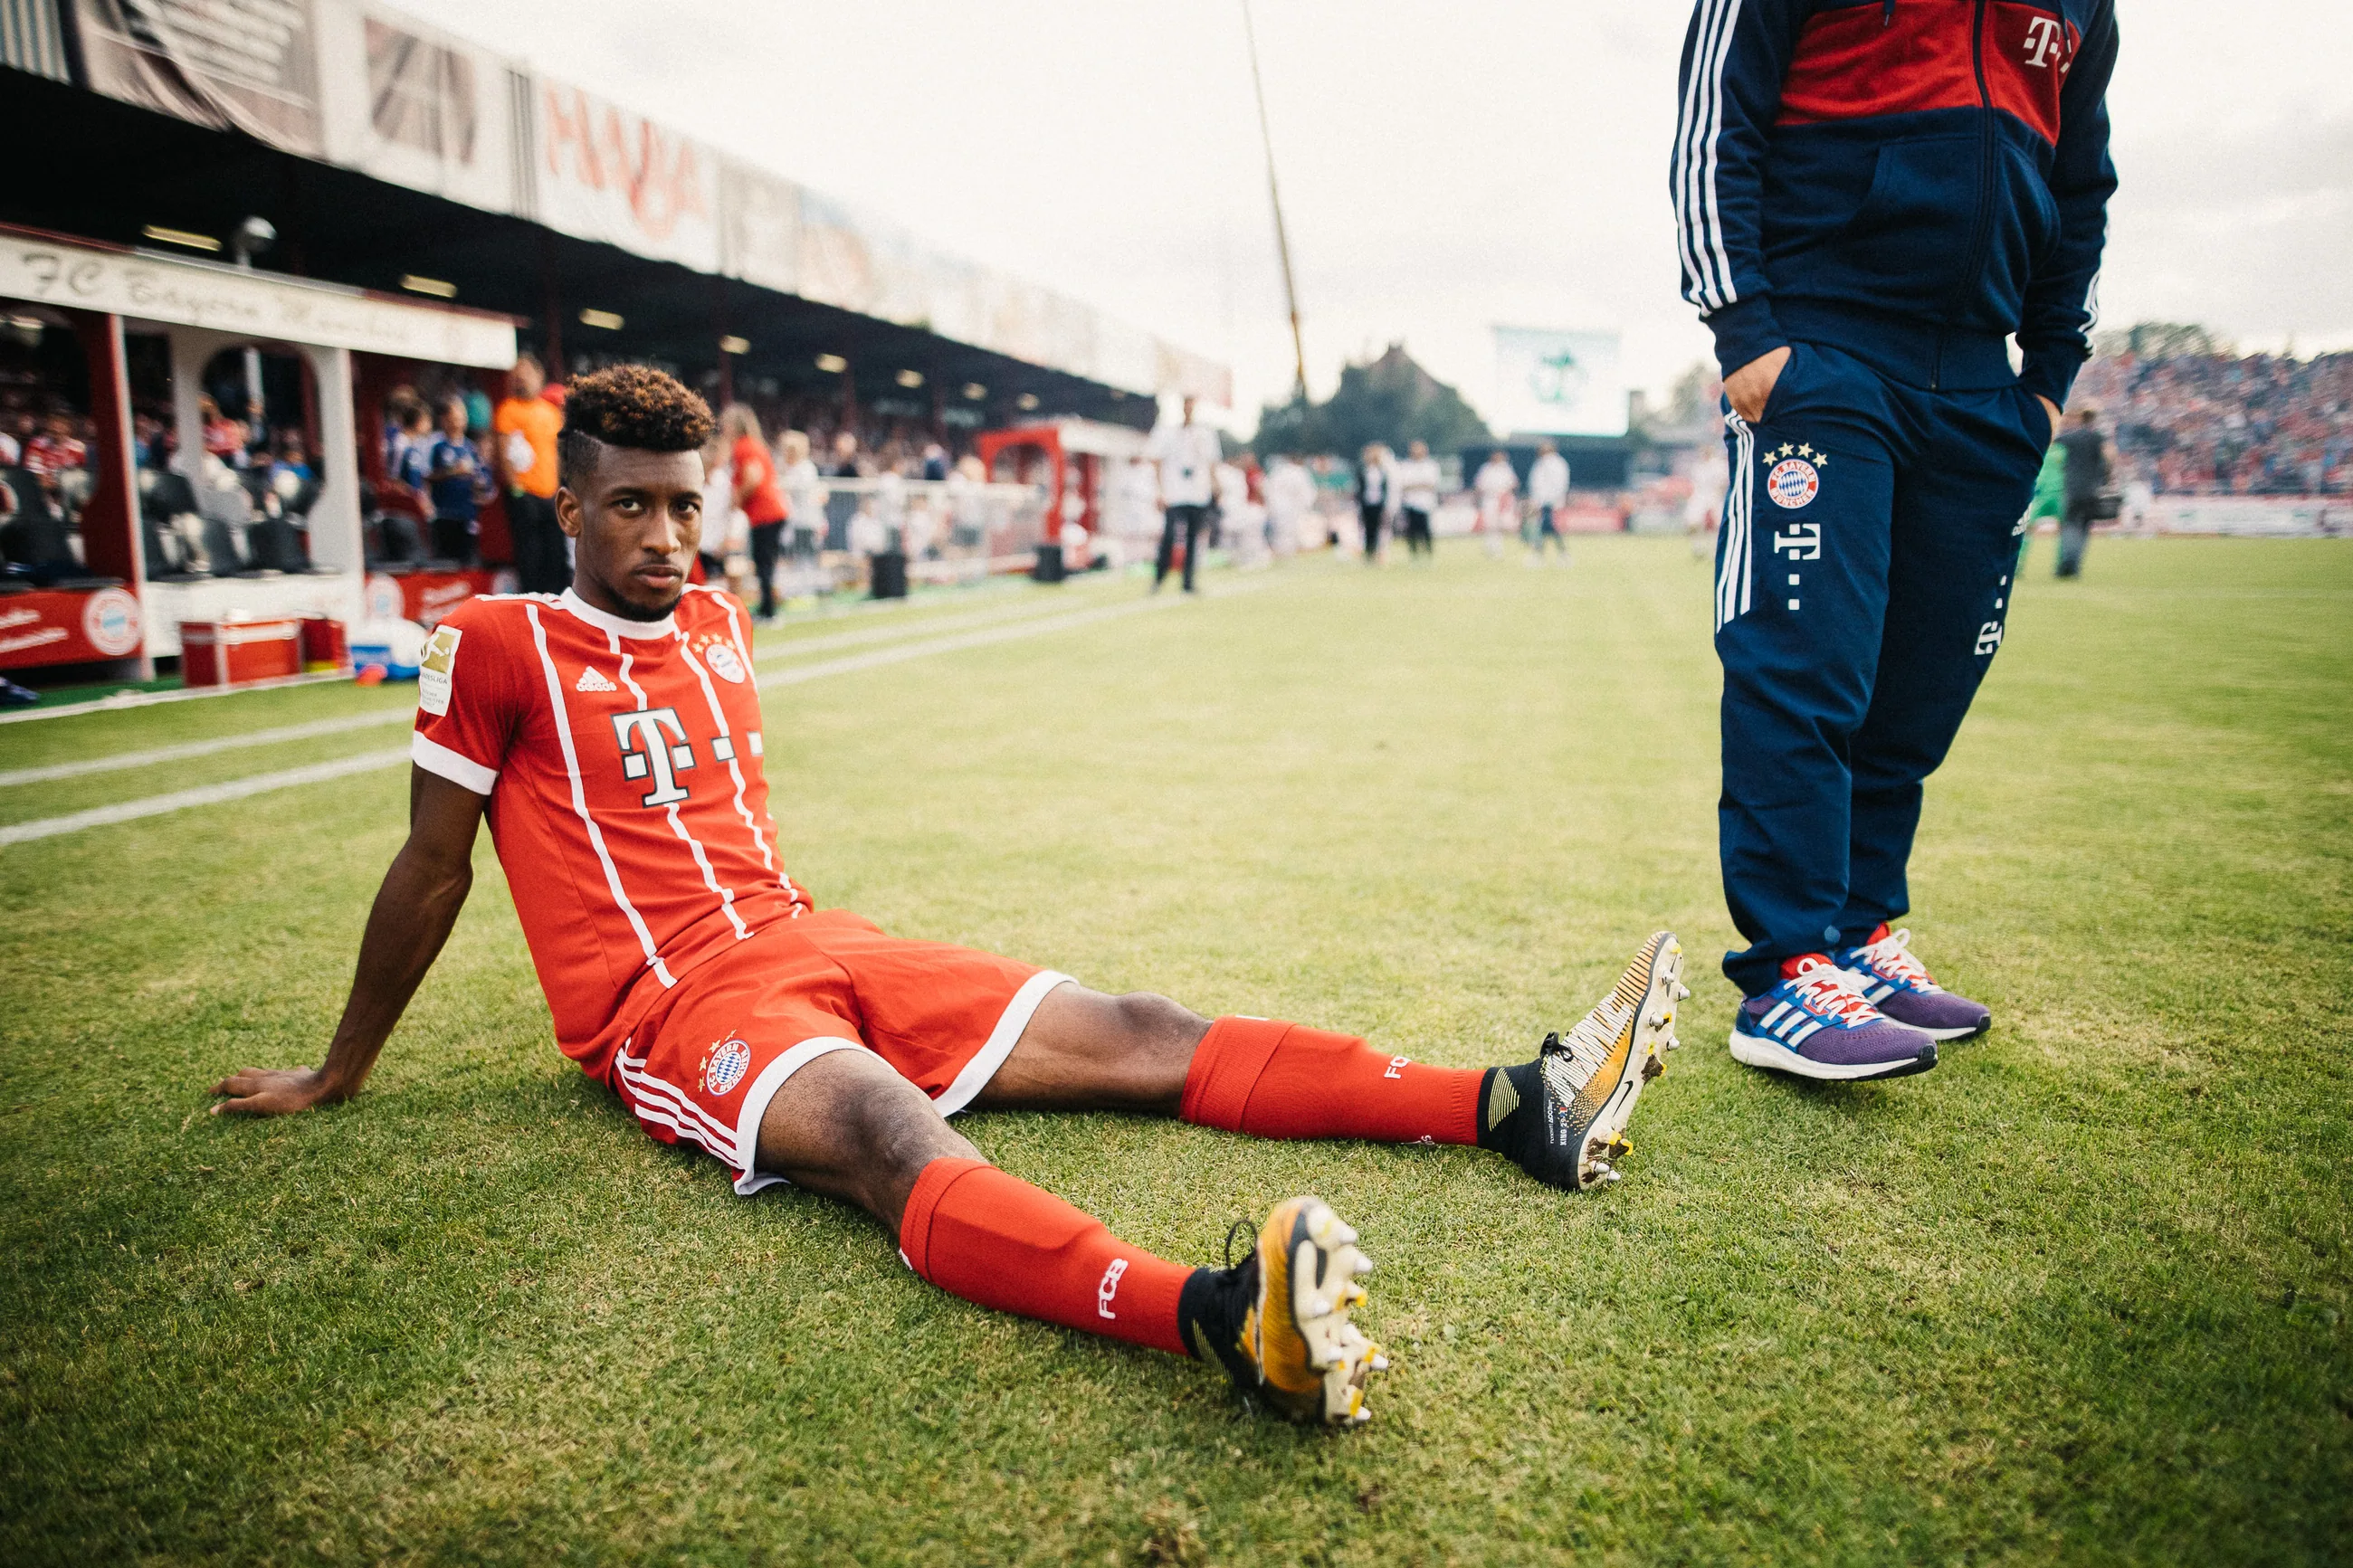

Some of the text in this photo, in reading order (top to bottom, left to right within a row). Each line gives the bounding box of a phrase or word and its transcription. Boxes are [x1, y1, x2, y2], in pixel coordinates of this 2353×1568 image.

[1782, 461, 1817, 482] BAYERN
[576, 681, 617, 692] adidas
[710, 1042, 739, 1074] BAYERN
[1098, 1258, 1129, 1320] FCB
